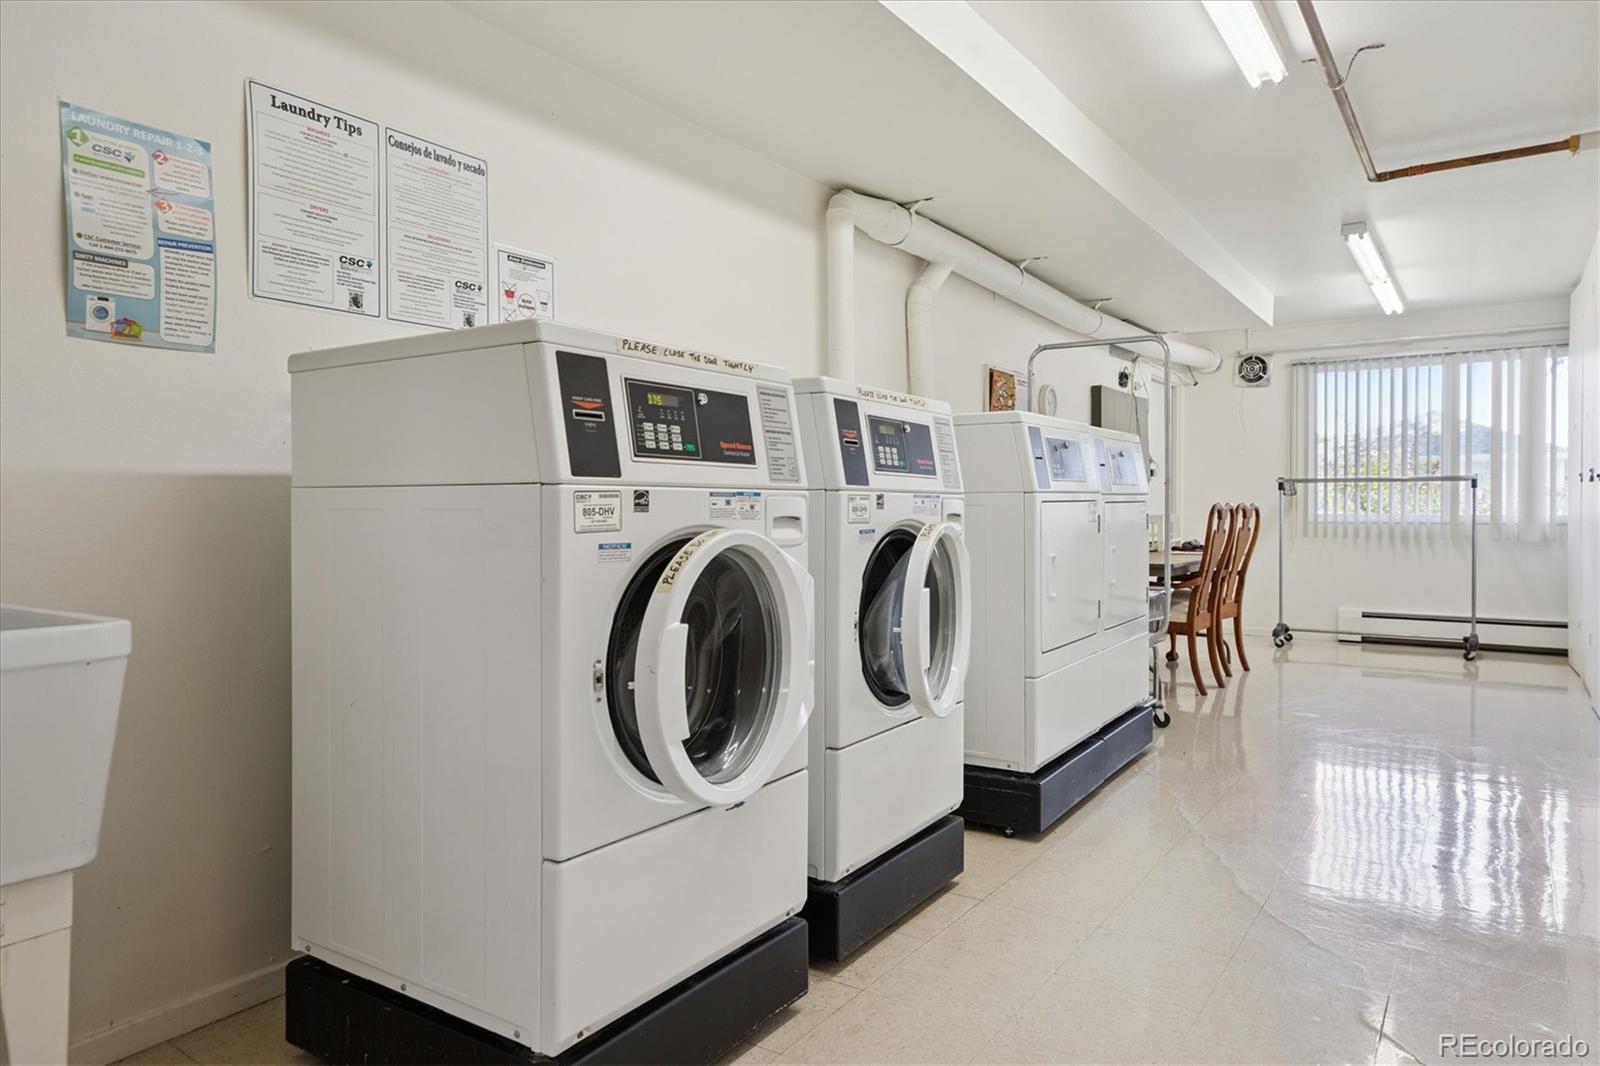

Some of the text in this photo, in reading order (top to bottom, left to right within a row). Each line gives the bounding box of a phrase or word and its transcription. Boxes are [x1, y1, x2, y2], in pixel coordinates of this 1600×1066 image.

[270, 94, 363, 137] Laundry Tips
[71, 112, 131, 135] LAUNDRY
[132, 128, 175, 147] REPAIR
[72, 129, 82, 145] 1
[91, 143, 122, 158] CSC
[156, 151, 165, 164] 2
[388, 134, 422, 157] Consejos
[423, 146, 433, 159] de
[433, 149, 457, 168] lavado
[457, 160, 463, 172] y
[463, 161, 486, 177] secado
[158, 200, 169, 213] 3
[95, 236, 122, 248] Customer
[178, 242, 212, 251] PREVENTION
[339, 255, 365, 268] CSC
[455, 280, 477, 291] CSC
[622, 338, 754, 374] PLEASE CLOSE THE DOOR TIGHTLY
[582, 507, 615, 517] 805-DHV
[662, 549, 693, 585] PLEASE
